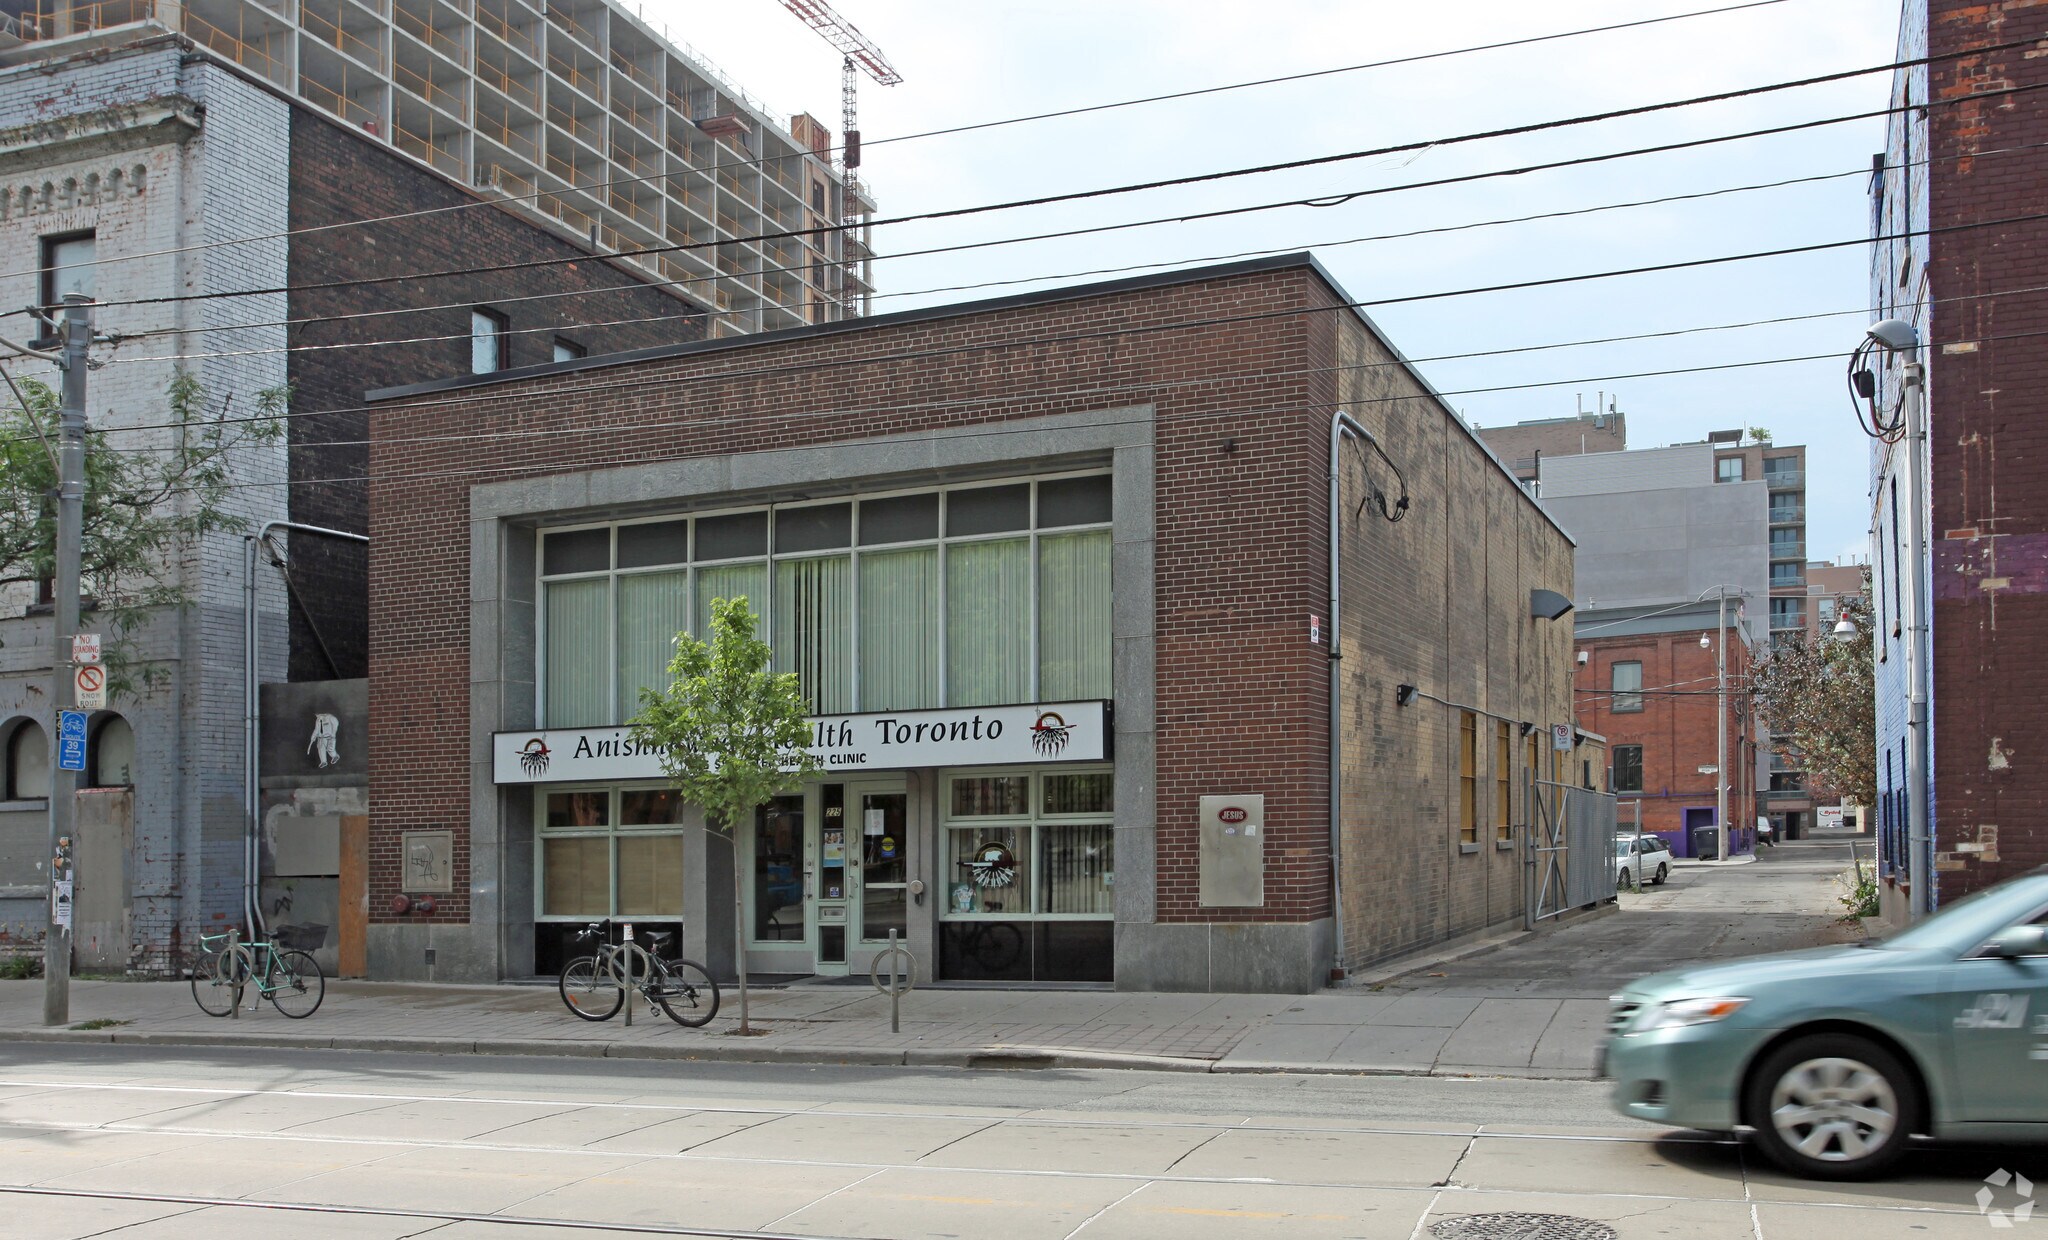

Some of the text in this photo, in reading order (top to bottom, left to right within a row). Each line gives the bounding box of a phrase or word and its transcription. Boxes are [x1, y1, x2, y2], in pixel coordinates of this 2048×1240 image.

[80, 634, 91, 645] NO
[74, 644, 99, 655] STANDING
[80, 699, 102, 707] ROUT
[875, 715, 1003, 745] Toronto
[66, 740, 79, 750] 39
[829, 753, 867, 765] CLINIC
[826, 807, 842, 817] 225
[1221, 810, 1244, 820] JESUS
